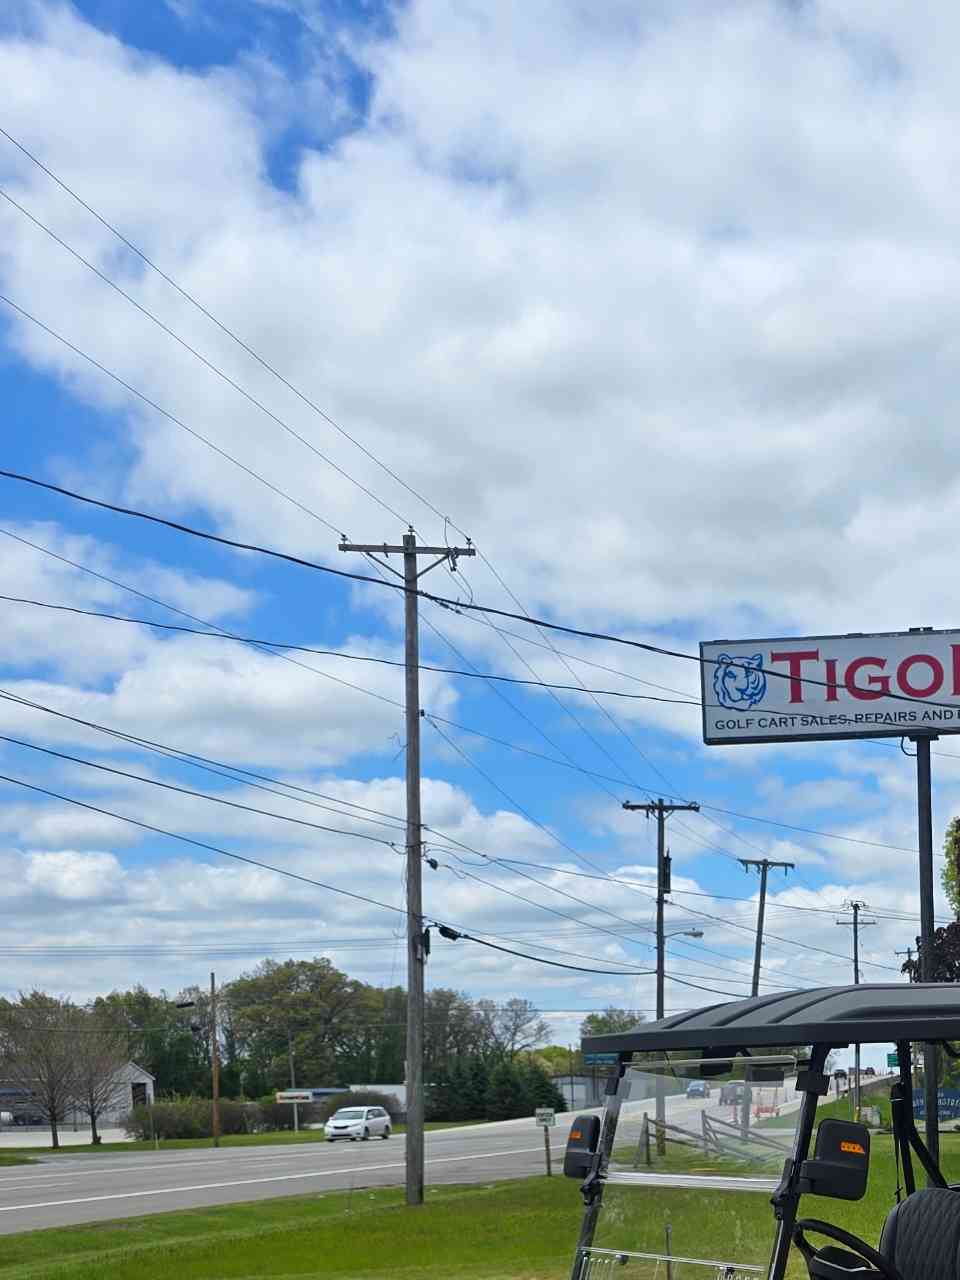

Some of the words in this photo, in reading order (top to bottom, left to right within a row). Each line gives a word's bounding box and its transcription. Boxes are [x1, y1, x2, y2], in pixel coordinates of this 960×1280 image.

[715, 719, 754, 730] GOLF
[758, 717, 798, 728] CART
[855, 711, 917, 723] REPAIRS
[922, 709, 953, 721] AND
